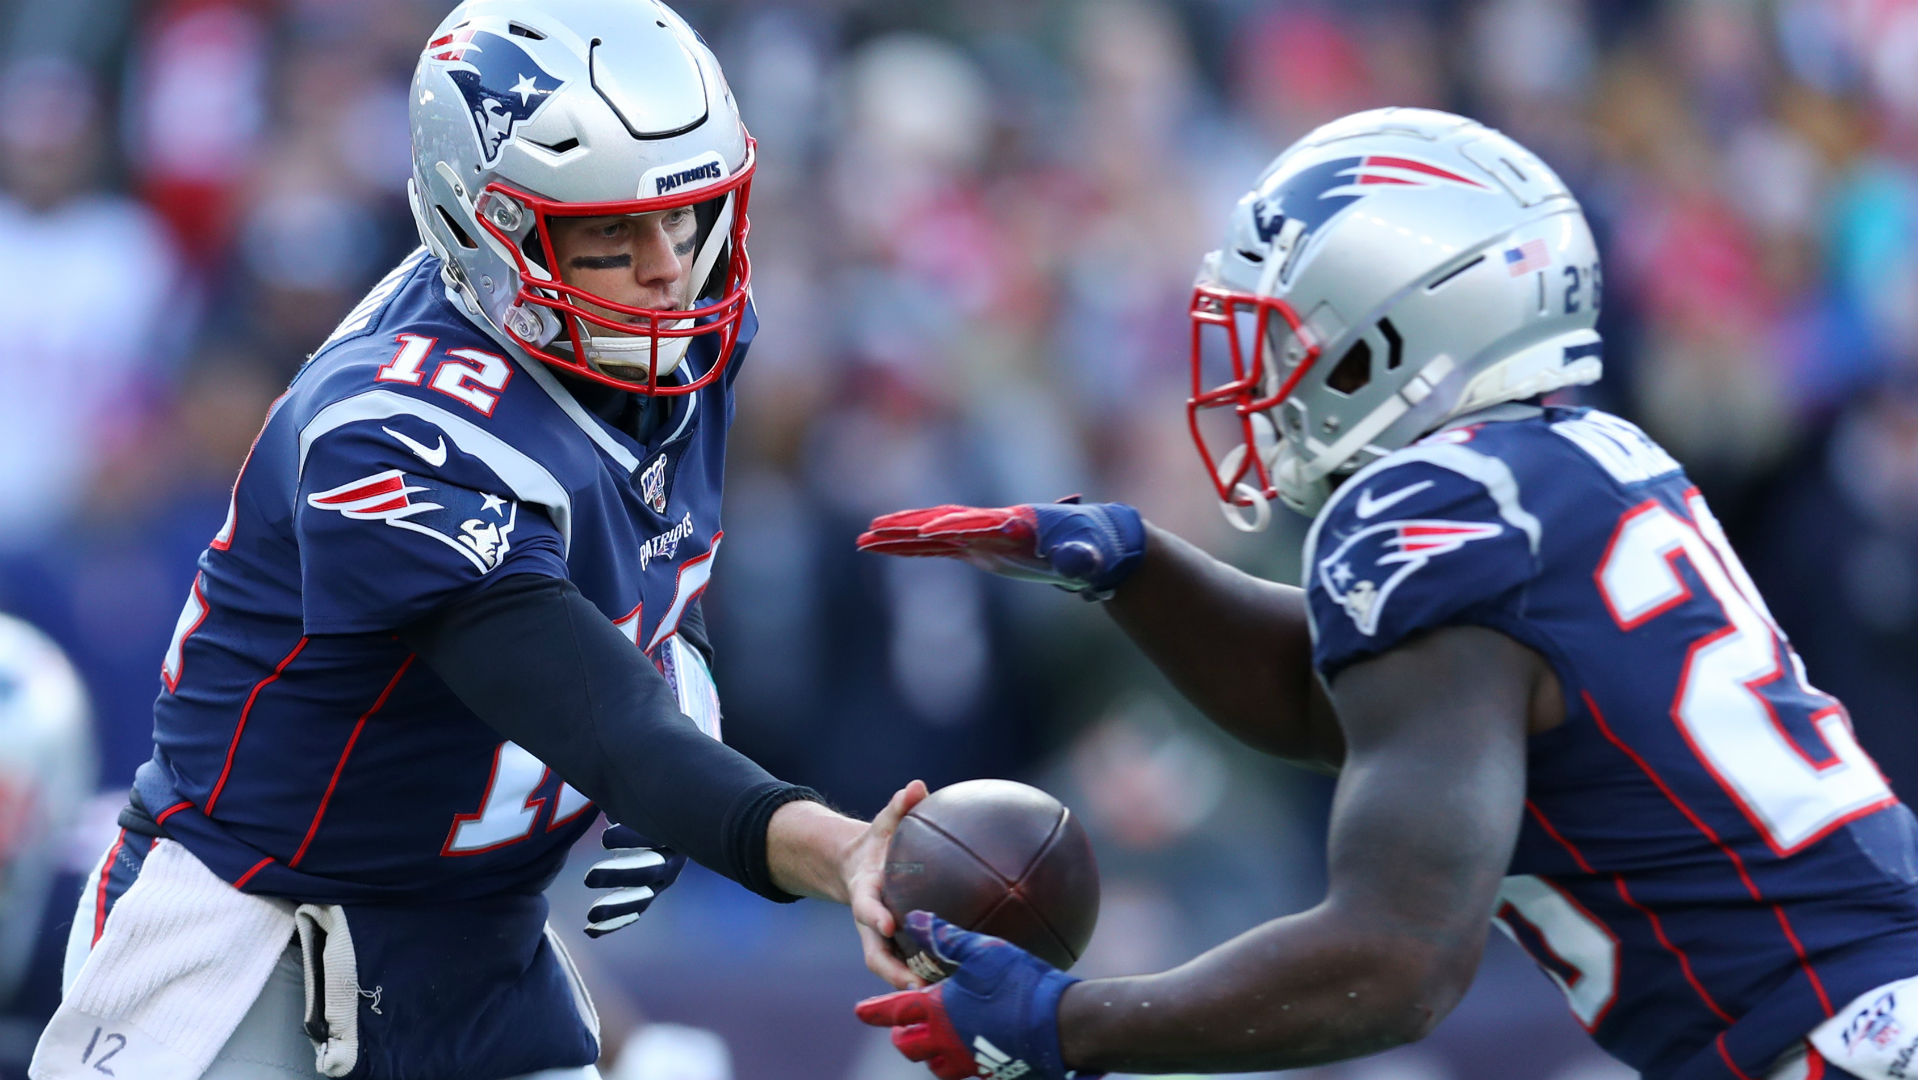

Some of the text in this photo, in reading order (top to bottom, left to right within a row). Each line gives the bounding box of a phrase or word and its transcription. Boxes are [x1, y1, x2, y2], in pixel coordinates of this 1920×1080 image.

[656, 161, 721, 195] PATRIOTS
[375, 332, 513, 417] 12
[640, 512, 694, 571] PATRIOTS
[81, 1026, 127, 1076] 12
